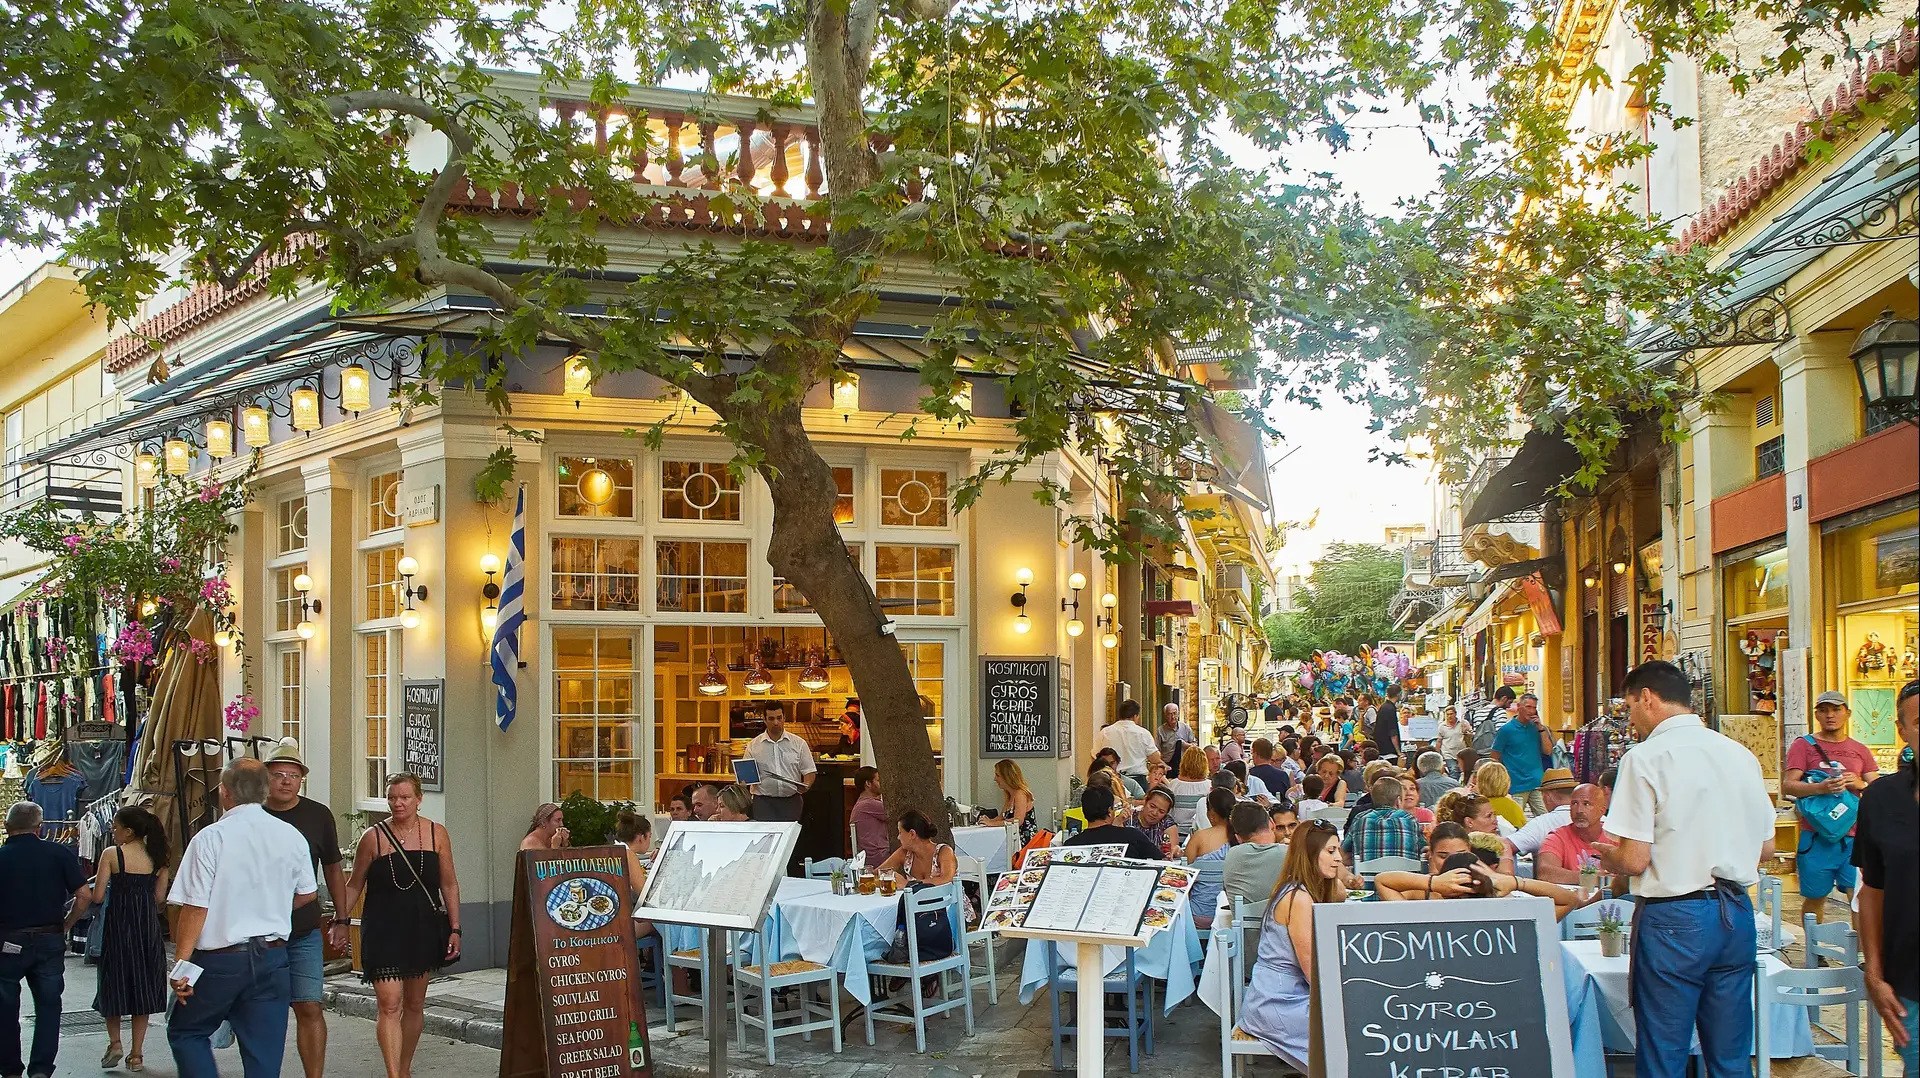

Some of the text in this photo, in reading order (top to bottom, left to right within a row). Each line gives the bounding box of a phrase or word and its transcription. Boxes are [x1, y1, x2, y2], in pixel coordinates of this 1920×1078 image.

[988, 662, 1047, 677] KOSMIKON
[406, 687, 440, 705] KOSMIKON
[990, 685, 1038, 700] GYROS
[992, 699, 1034, 713] KEBAB
[408, 713, 431, 728] GYROS
[989, 711, 1042, 726] SOUVLAKI
[406, 727, 434, 743] MOUSAKA
[990, 723, 1037, 737] MOUSAKA
[990, 734, 1013, 742] MIXED
[407, 740, 437, 756] BURGERS
[989, 743, 1013, 751] MIXED
[408, 763, 436, 780] STEAKS
[553, 933, 620, 949] Το Κοσμικόν
[1340, 925, 1517, 966] KOSMIKON
[548, 954, 581, 969] GYROS
[550, 967, 627, 988] CHICKEN GYROS
[552, 990, 600, 1007] SOUVLAKI
[1383, 994, 1497, 1021] GYROS
[554, 1007, 618, 1027] MIXED GRILL
[1361, 1023, 1519, 1056] SOUVLAKI
[559, 1049, 593, 1065] GREEK
[593, 1045, 623, 1060] SALAD
[594, 1064, 621, 1078] BEER
